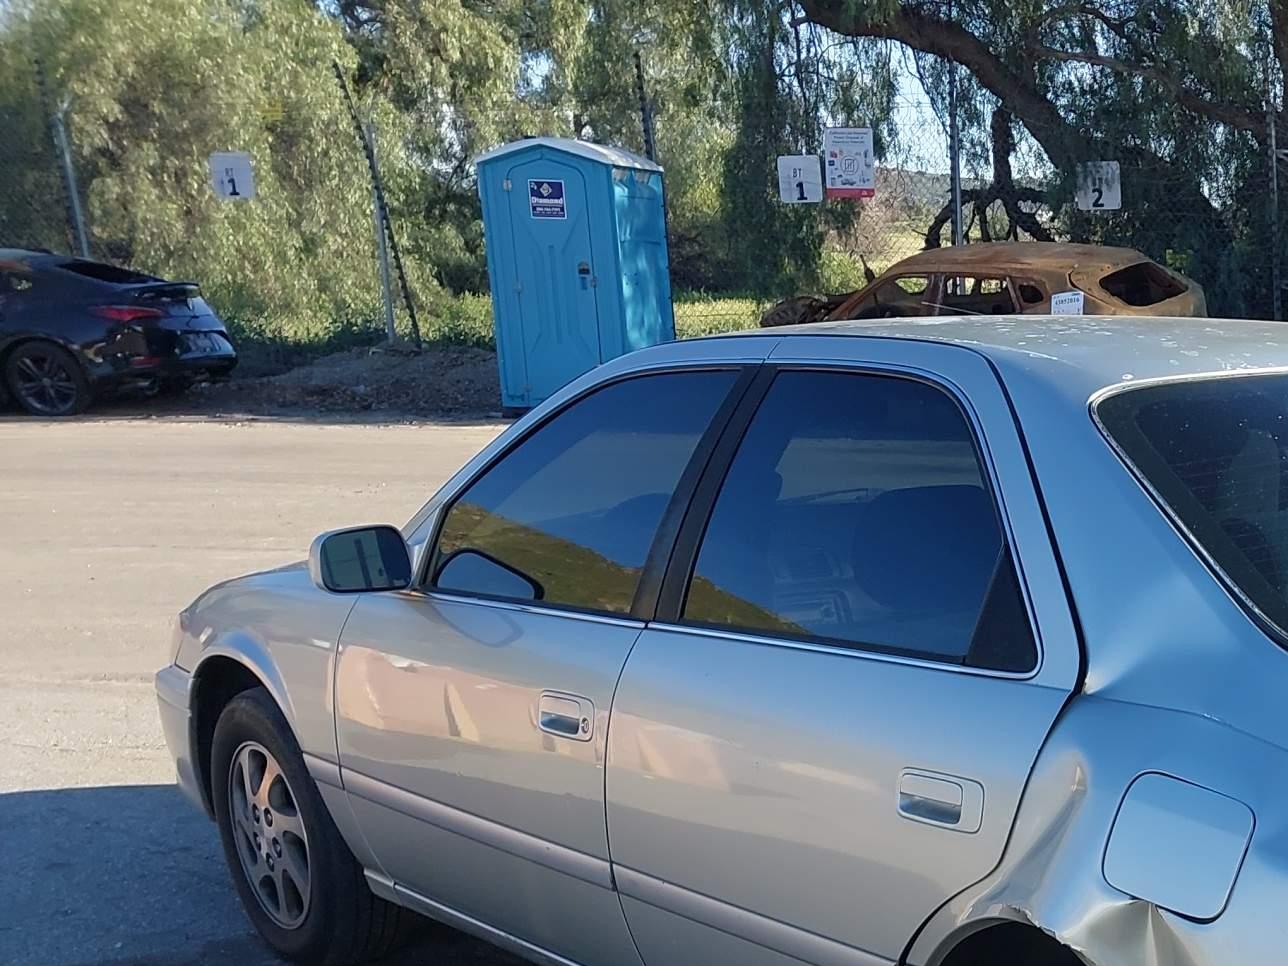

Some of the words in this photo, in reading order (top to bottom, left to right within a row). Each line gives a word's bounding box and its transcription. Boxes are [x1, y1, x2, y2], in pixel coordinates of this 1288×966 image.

[227, 178, 240, 196] 1
[796, 182, 808, 201] 1
[1091, 188, 1105, 208] 2
